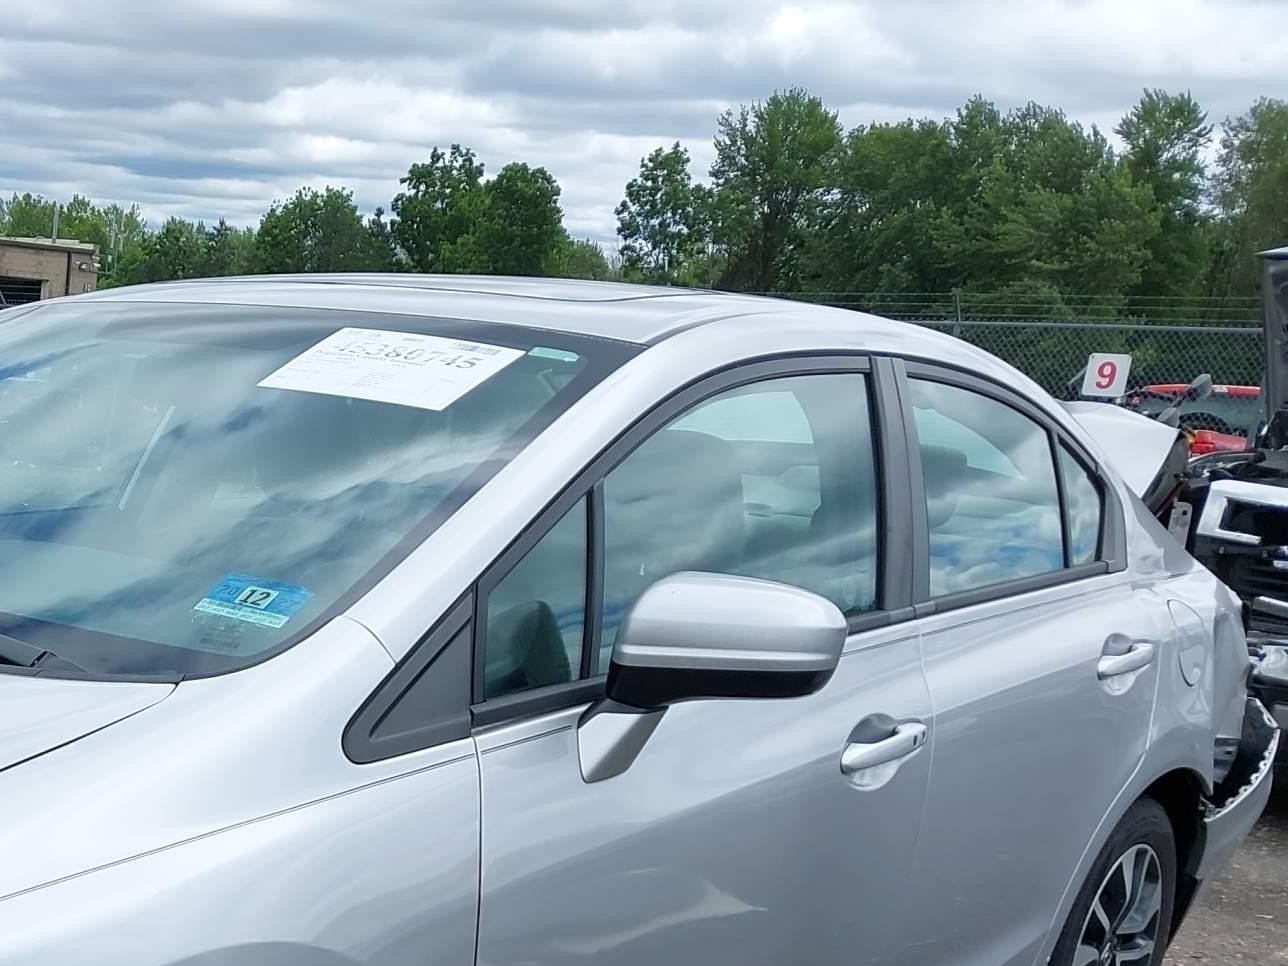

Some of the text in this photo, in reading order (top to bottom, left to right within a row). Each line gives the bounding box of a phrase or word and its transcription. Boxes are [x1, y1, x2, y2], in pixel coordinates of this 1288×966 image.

[333, 340, 484, 369] 45380745
[1095, 361, 1117, 389] 9
[219, 584, 241, 596] 20
[239, 589, 271, 606] 12
